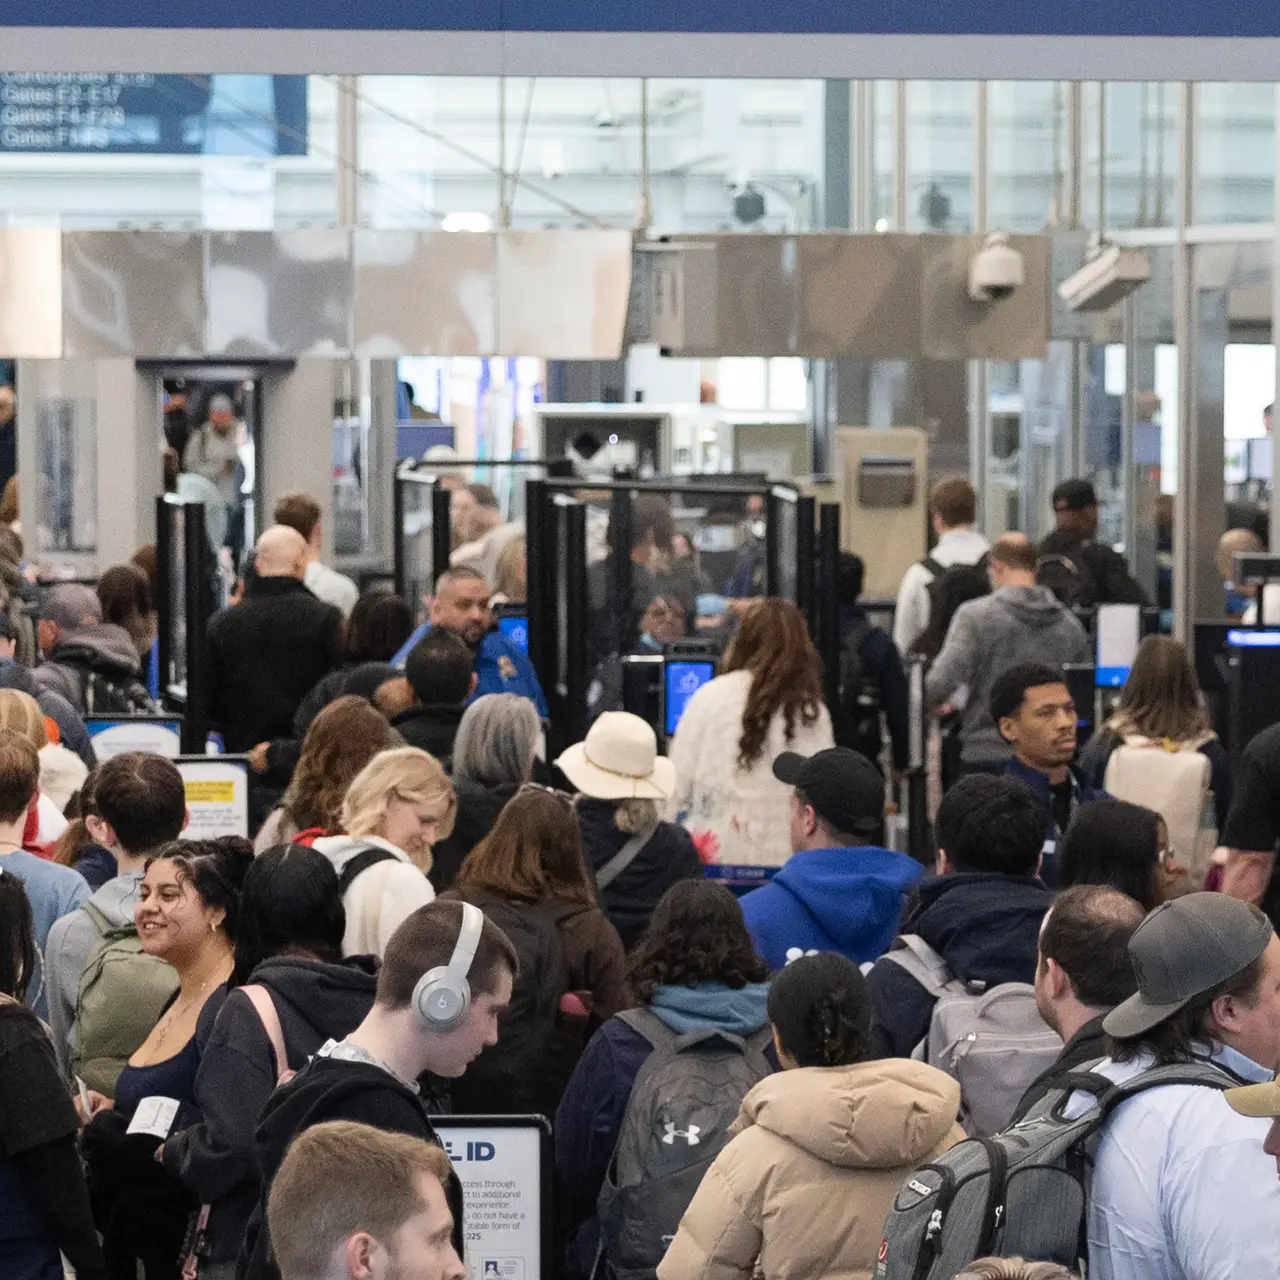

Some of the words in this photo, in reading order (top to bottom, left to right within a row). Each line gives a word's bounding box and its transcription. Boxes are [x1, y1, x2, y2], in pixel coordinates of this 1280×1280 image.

[466, 1141, 496, 1162] ID
[484, 1180, 516, 1190] through
[482, 1190, 521, 1198] additional
[466, 1202, 509, 1210] experience
